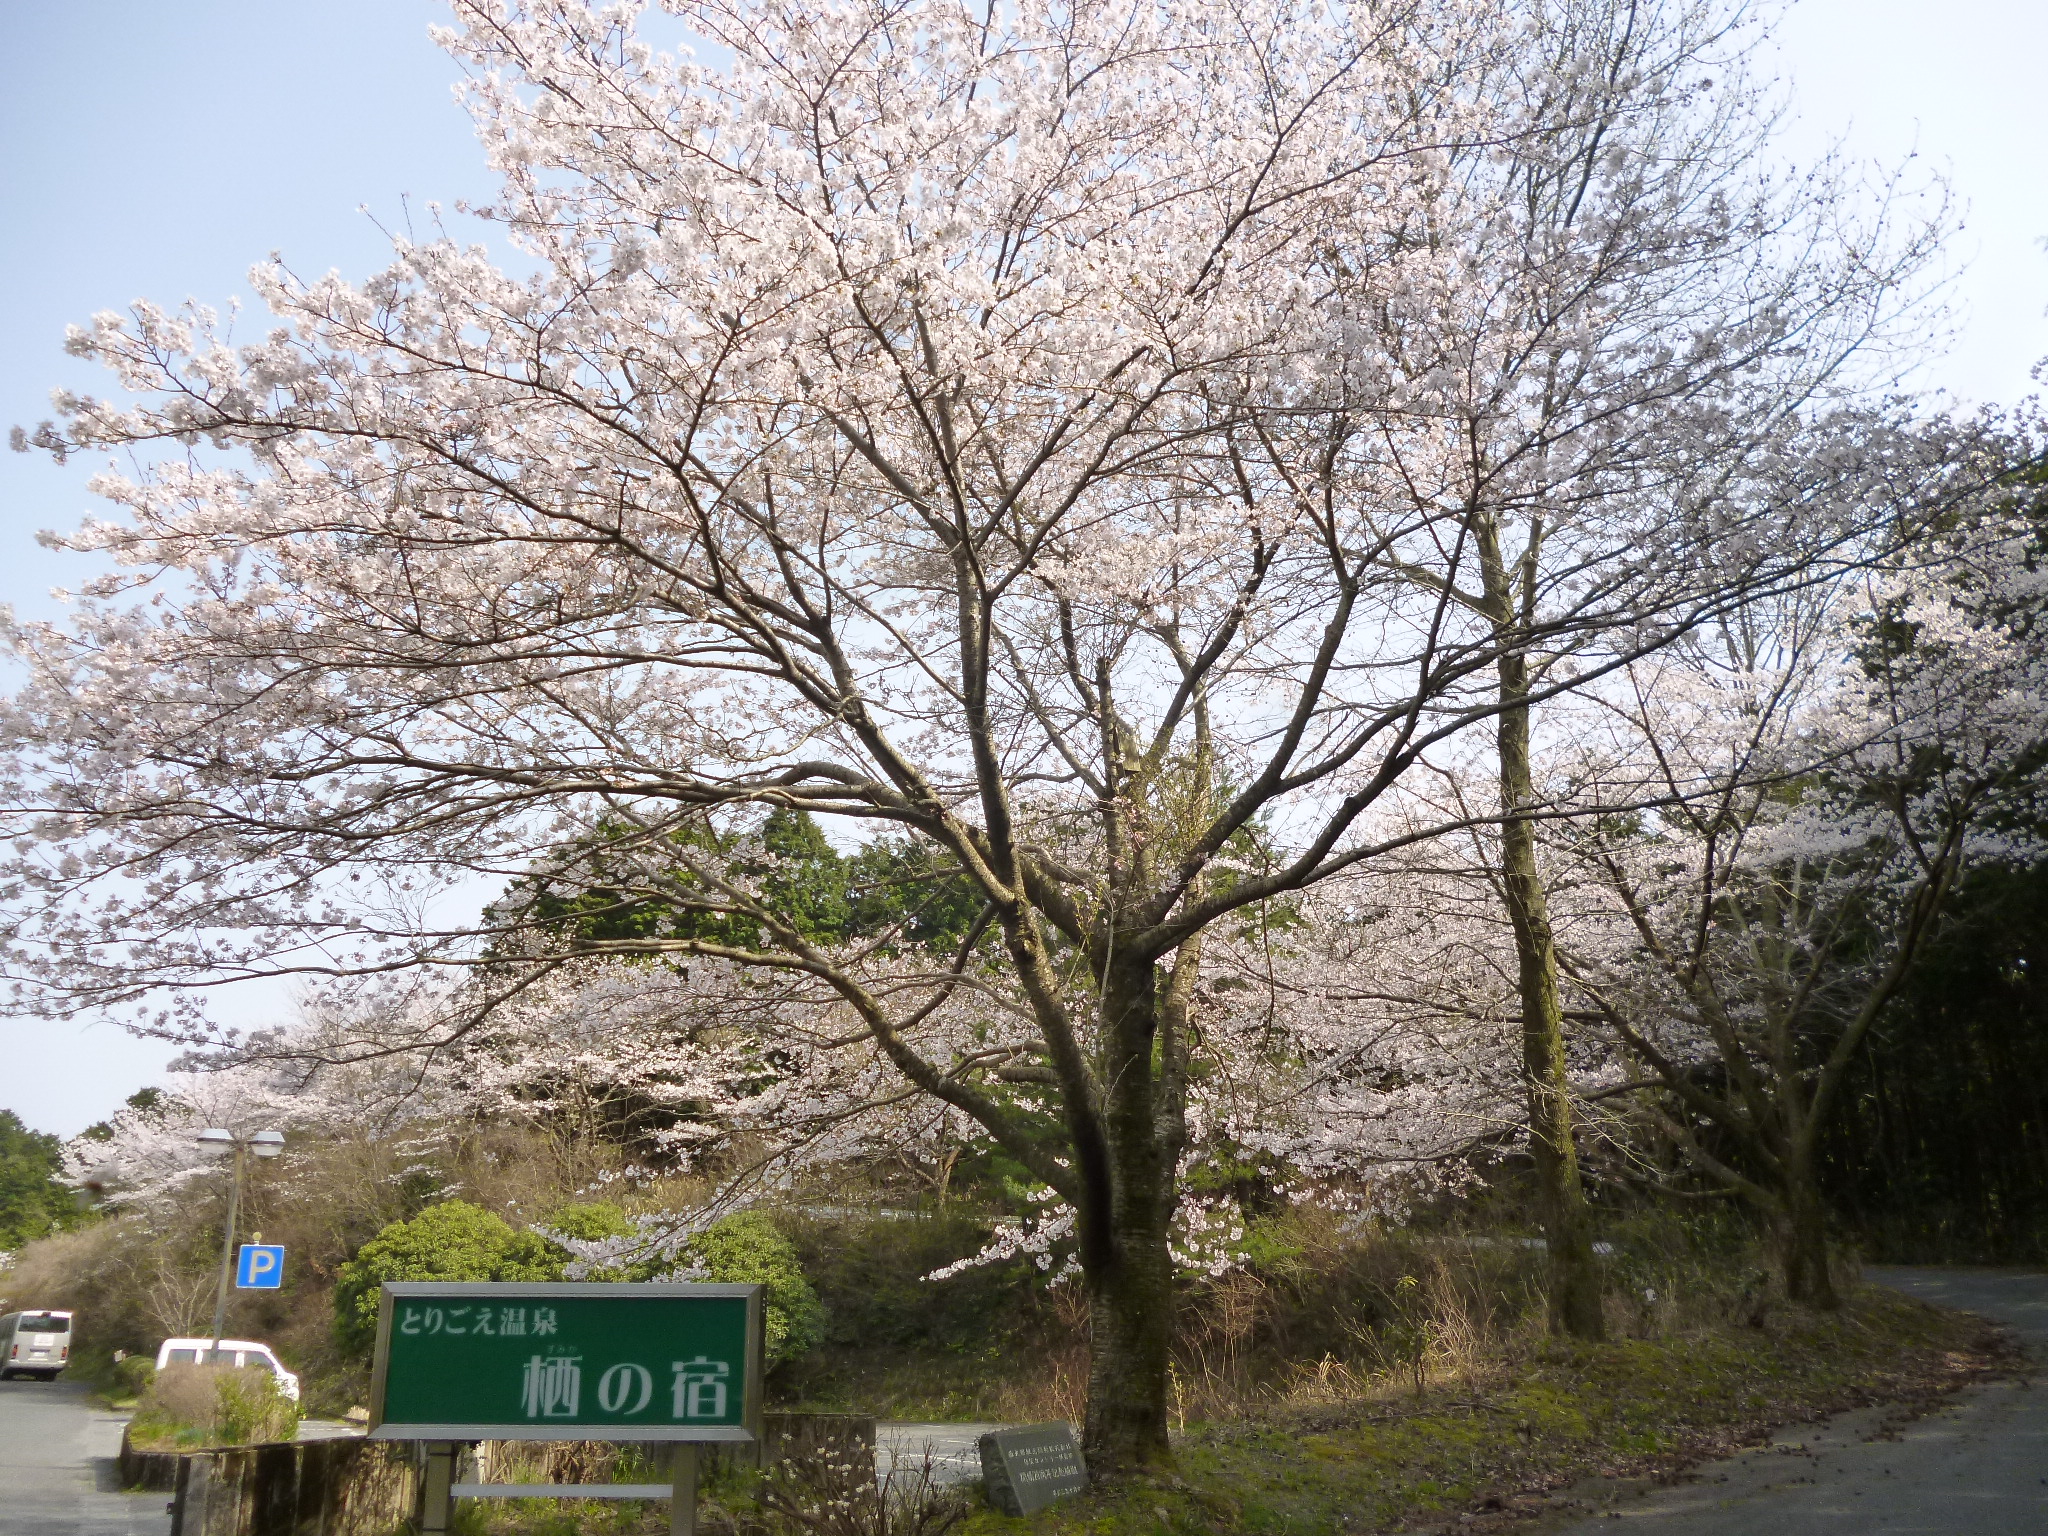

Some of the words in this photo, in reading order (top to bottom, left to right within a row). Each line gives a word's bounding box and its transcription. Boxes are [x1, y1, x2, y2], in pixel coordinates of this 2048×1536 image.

[249, 1251, 275, 1283] P
[401, 1307, 558, 1336] とりごえ温泉
[521, 1355, 729, 1418] 栖の宿
